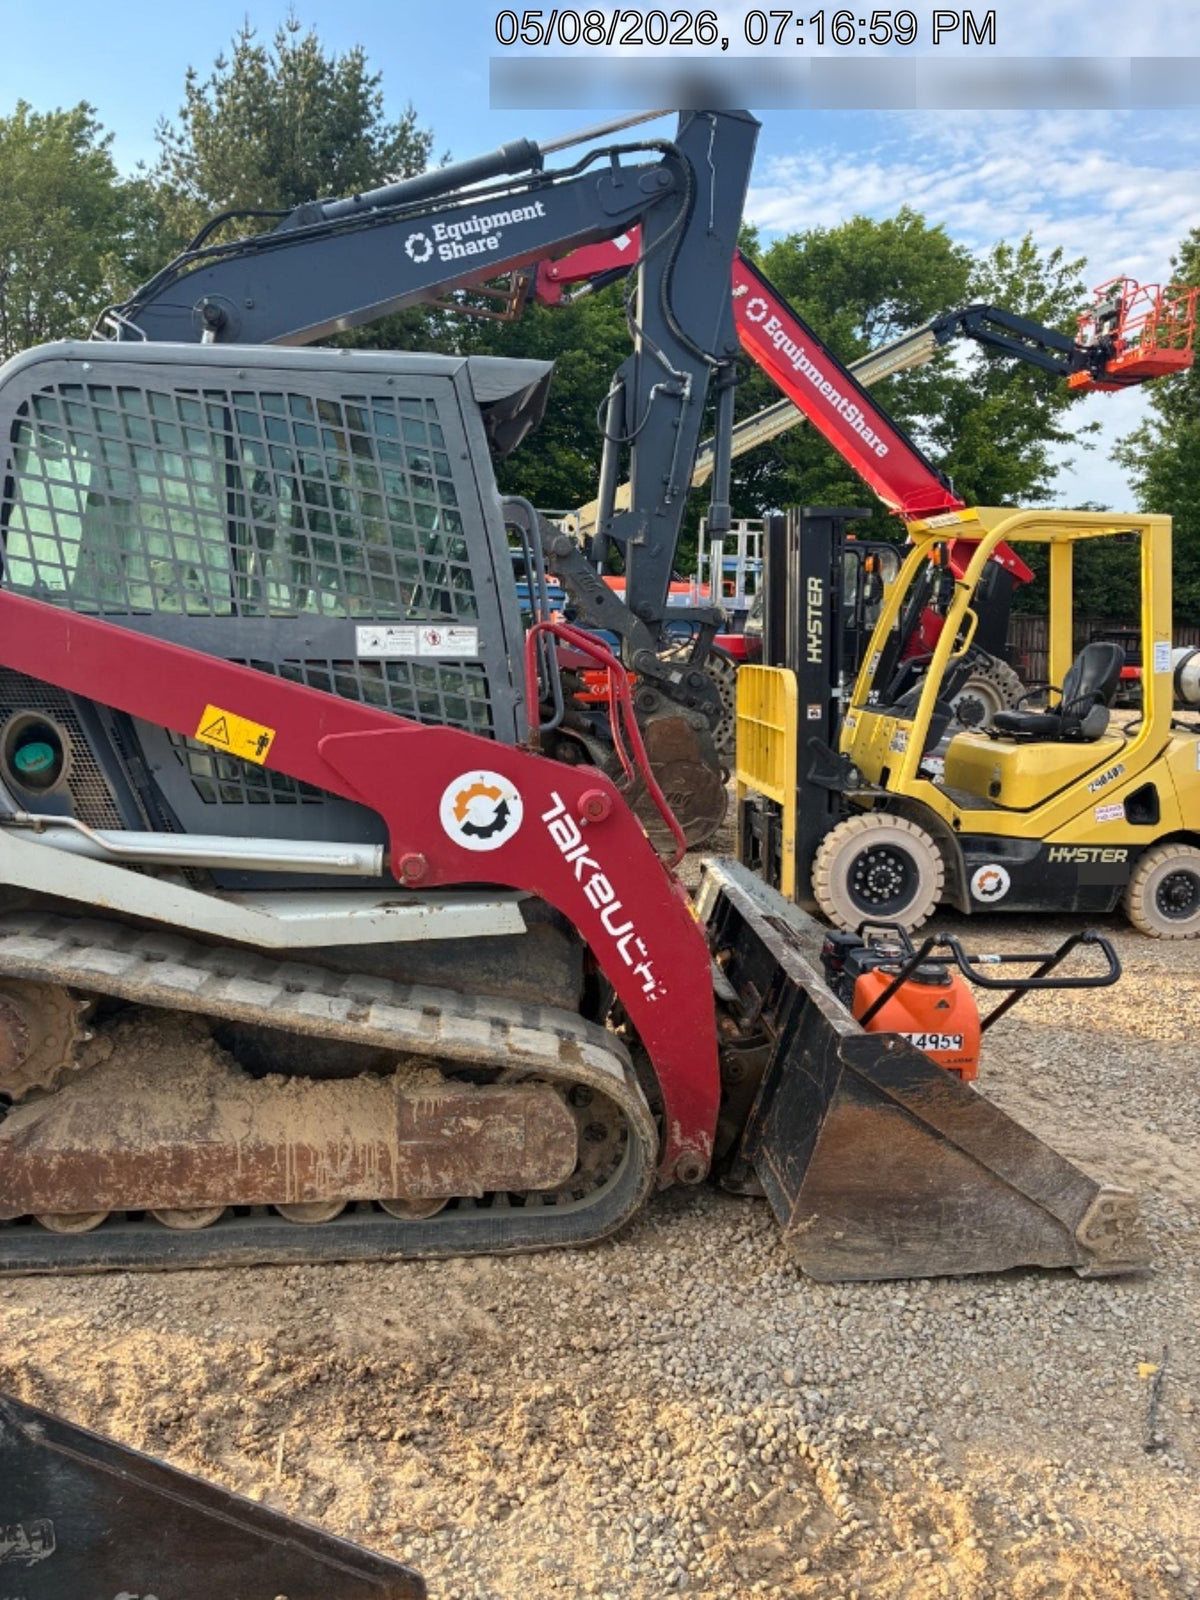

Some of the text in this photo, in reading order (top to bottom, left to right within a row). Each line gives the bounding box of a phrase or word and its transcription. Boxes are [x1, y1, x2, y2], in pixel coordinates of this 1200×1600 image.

[432, 200, 547, 242] Equipment
[761, 315, 890, 459] EquipmentShare
[806, 576, 823, 665] HYSTER
[1047, 847, 1128, 863] HYSTER
